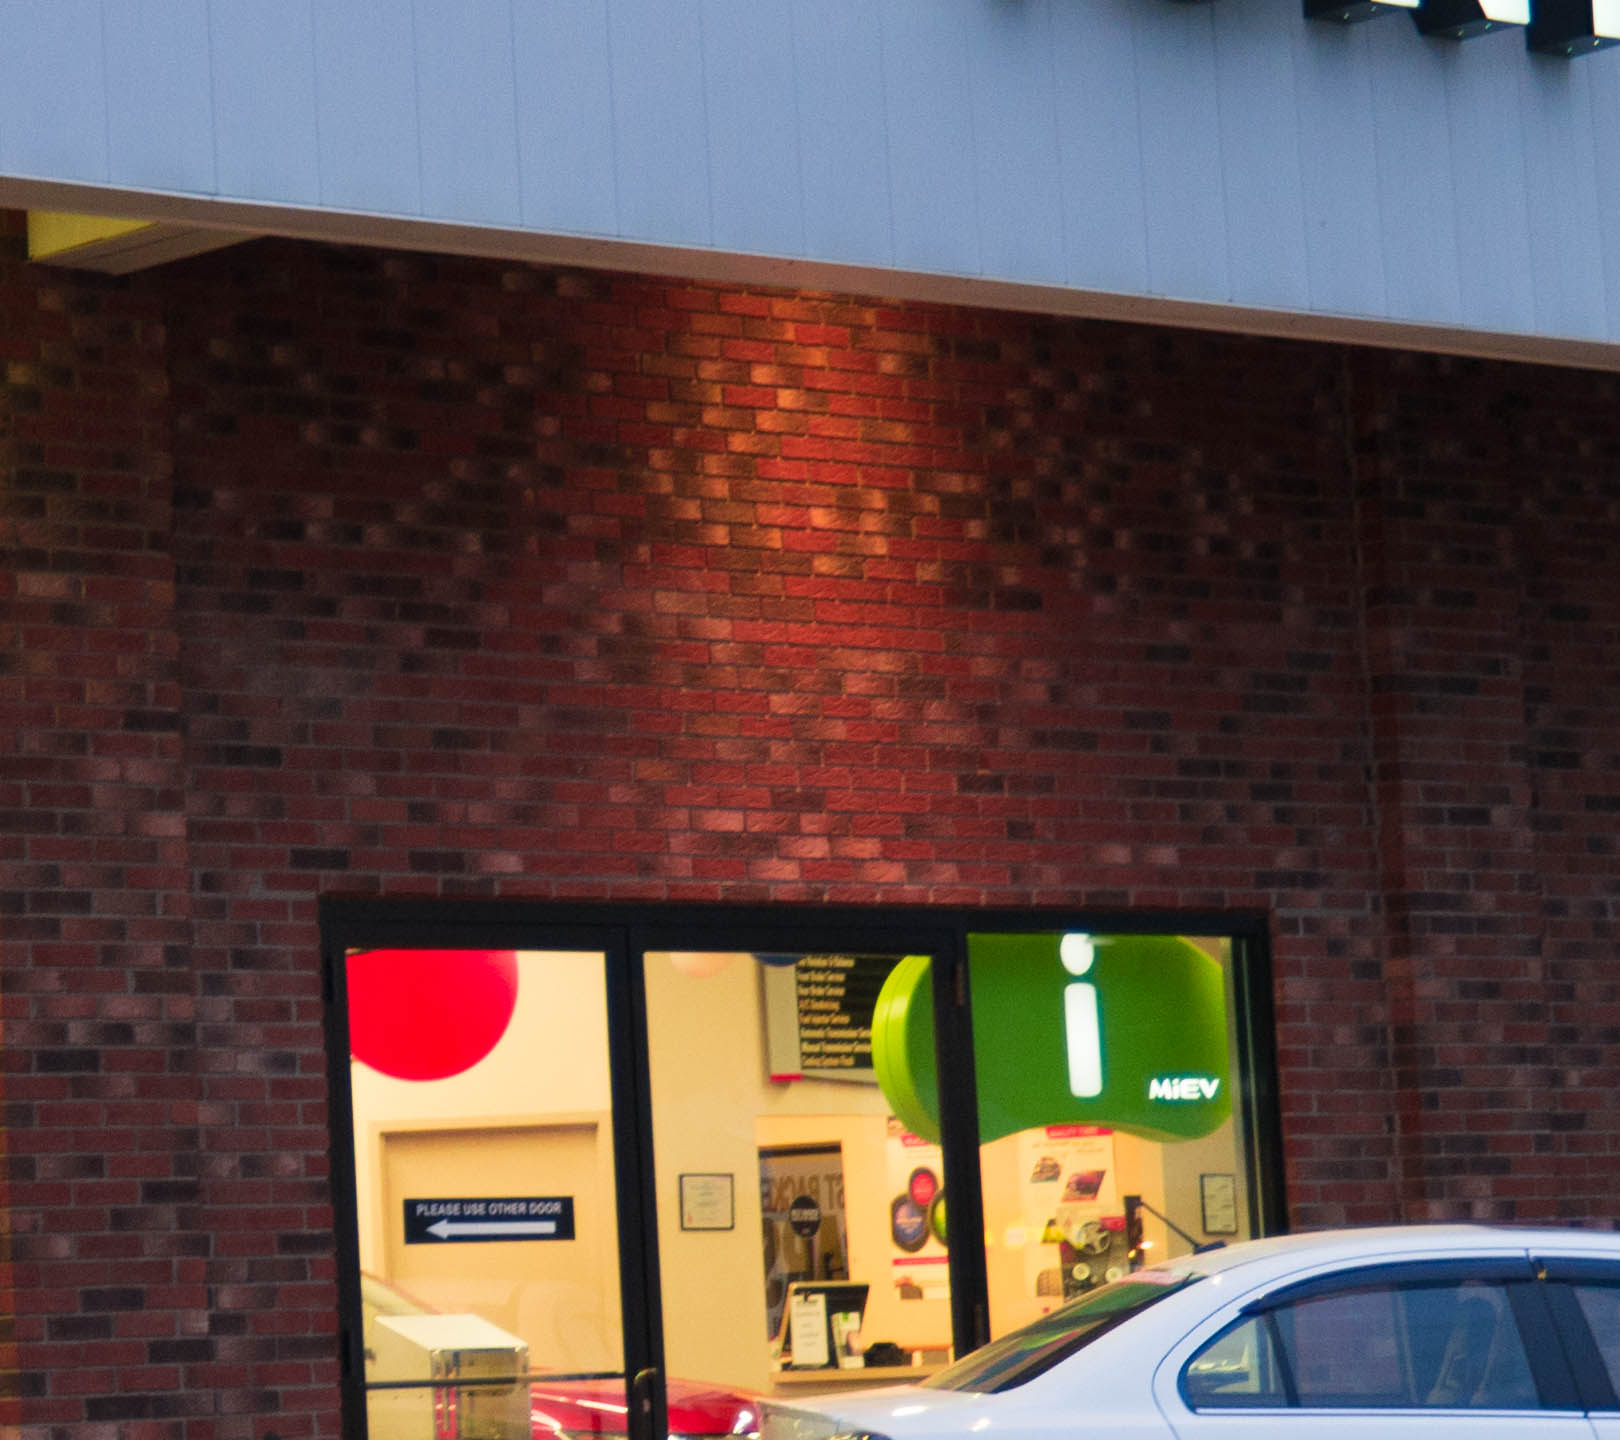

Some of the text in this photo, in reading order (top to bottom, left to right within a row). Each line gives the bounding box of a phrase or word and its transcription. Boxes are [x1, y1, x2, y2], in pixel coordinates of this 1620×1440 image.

[1059, 931, 1104, 1099] i
[1148, 1077, 1221, 1101] MiEV
[415, 1200, 563, 1217] PLEASE USE OTHER DOOR
